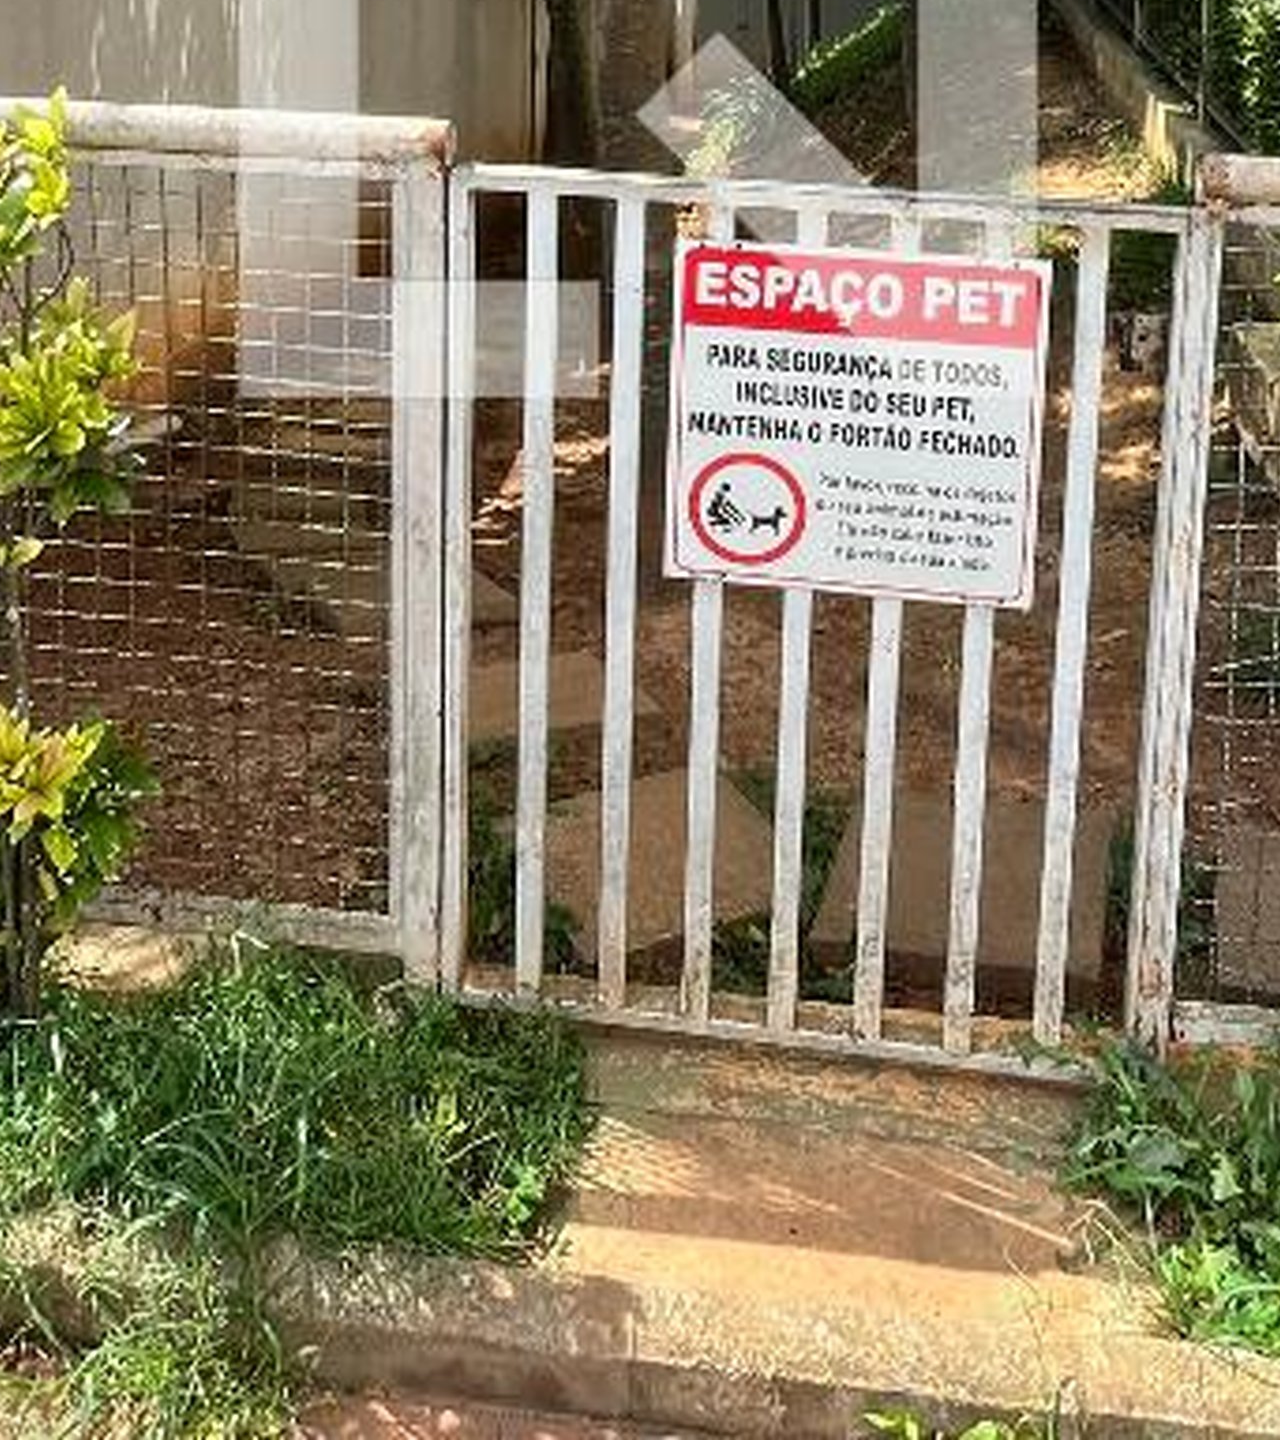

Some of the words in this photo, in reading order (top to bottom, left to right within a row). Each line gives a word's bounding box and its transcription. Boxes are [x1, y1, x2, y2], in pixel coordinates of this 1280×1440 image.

[695, 262, 903, 326] ESPAÇO
[924, 277, 1027, 326] PET
[707, 344, 760, 371] PARA
[767, 348, 892, 381] SEGURANÇA
[898, 359, 925, 383] DE
[931, 361, 1008, 390] TODOS,
[736, 381, 844, 410] INCLUSIVE
[850, 389, 878, 414] DO
[885, 392, 926, 418] SEU
[932, 397, 975, 424] PET,
[688, 412, 802, 442] MANTENHA
[808, 421, 821, 444] O
[920, 430, 1020, 459] FECHADO.
